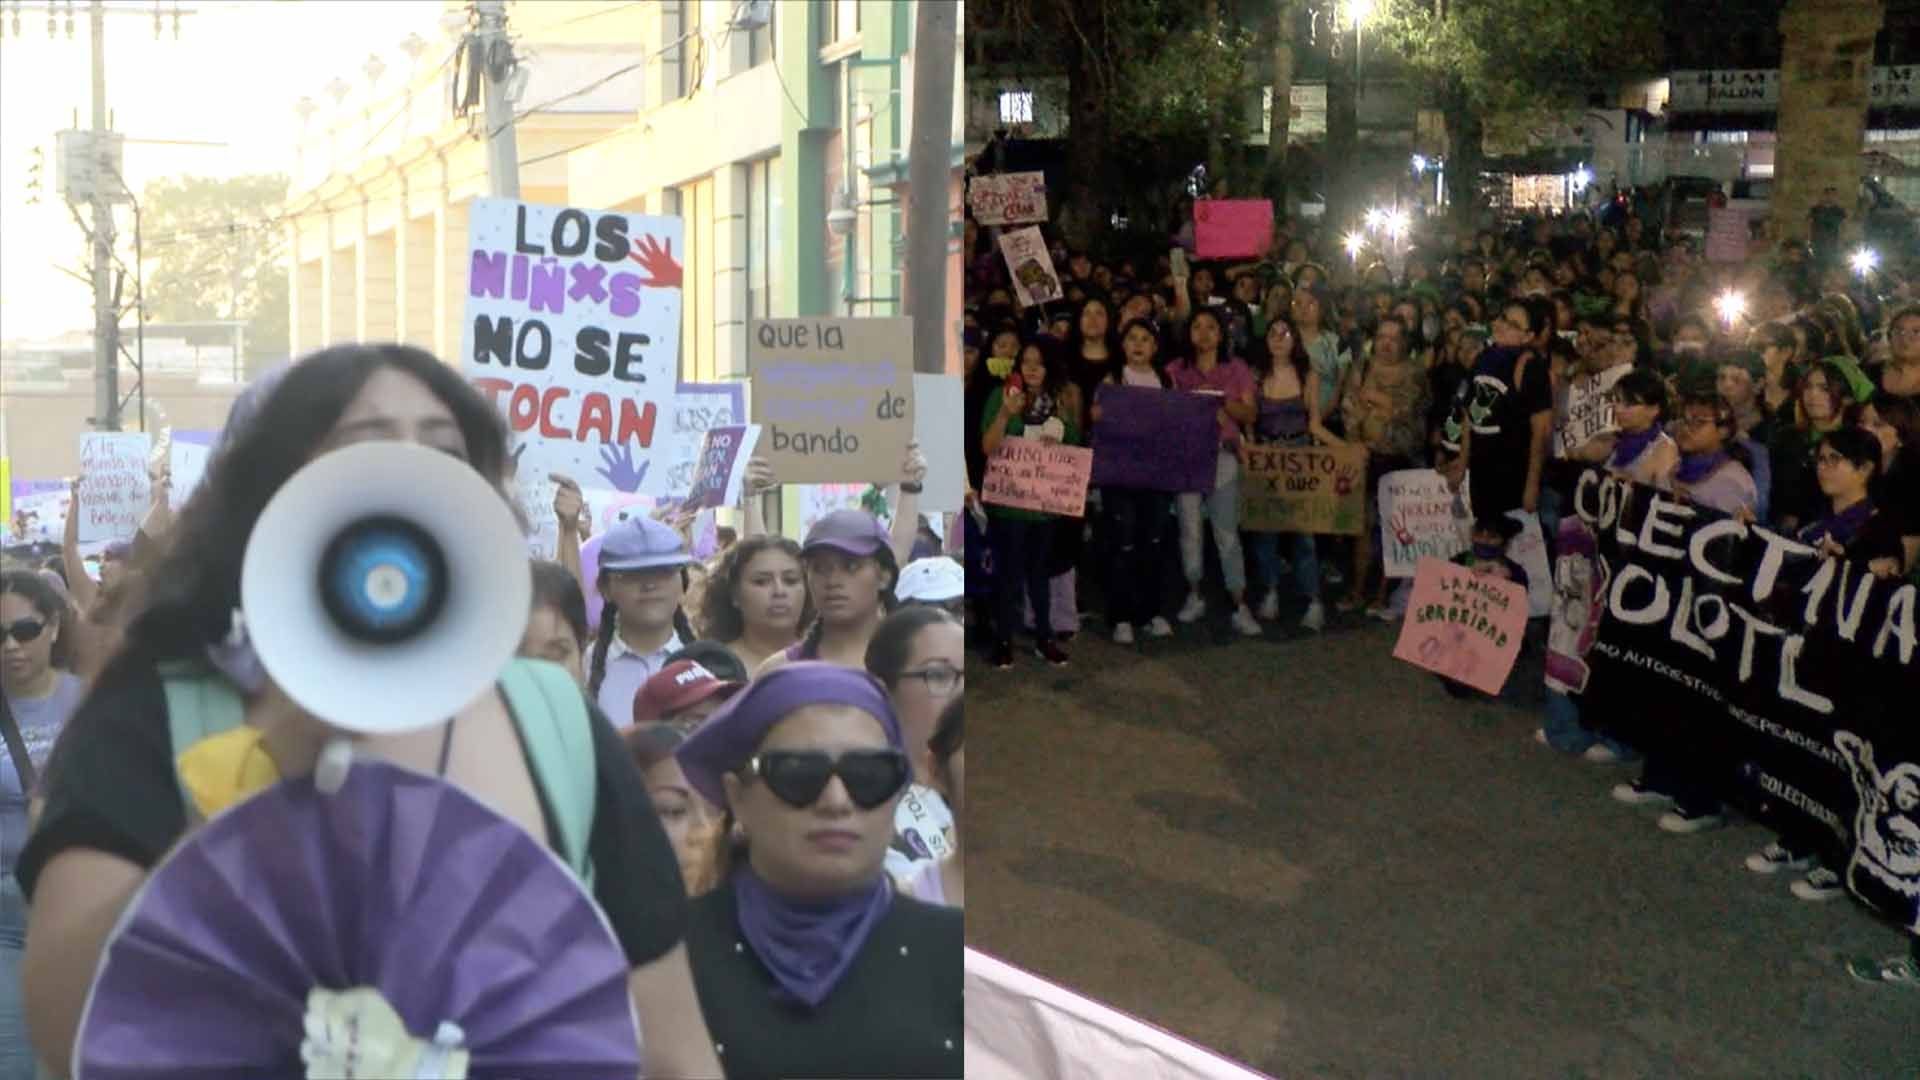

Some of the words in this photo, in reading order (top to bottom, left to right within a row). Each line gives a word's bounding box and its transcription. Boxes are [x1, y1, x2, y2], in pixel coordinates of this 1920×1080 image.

[515, 204, 631, 262] LOS
[470, 249, 641, 317] NIÑXS
[473, 314, 553, 371] NO
[574, 326, 651, 382] SE
[815, 323, 844, 350] la
[476, 378, 657, 448] TOCAN
[876, 390, 906, 420] de
[771, 424, 859, 455] bando
[1247, 451, 1336, 474] EXISTO
[1609, 563, 1835, 714] OLOTL
